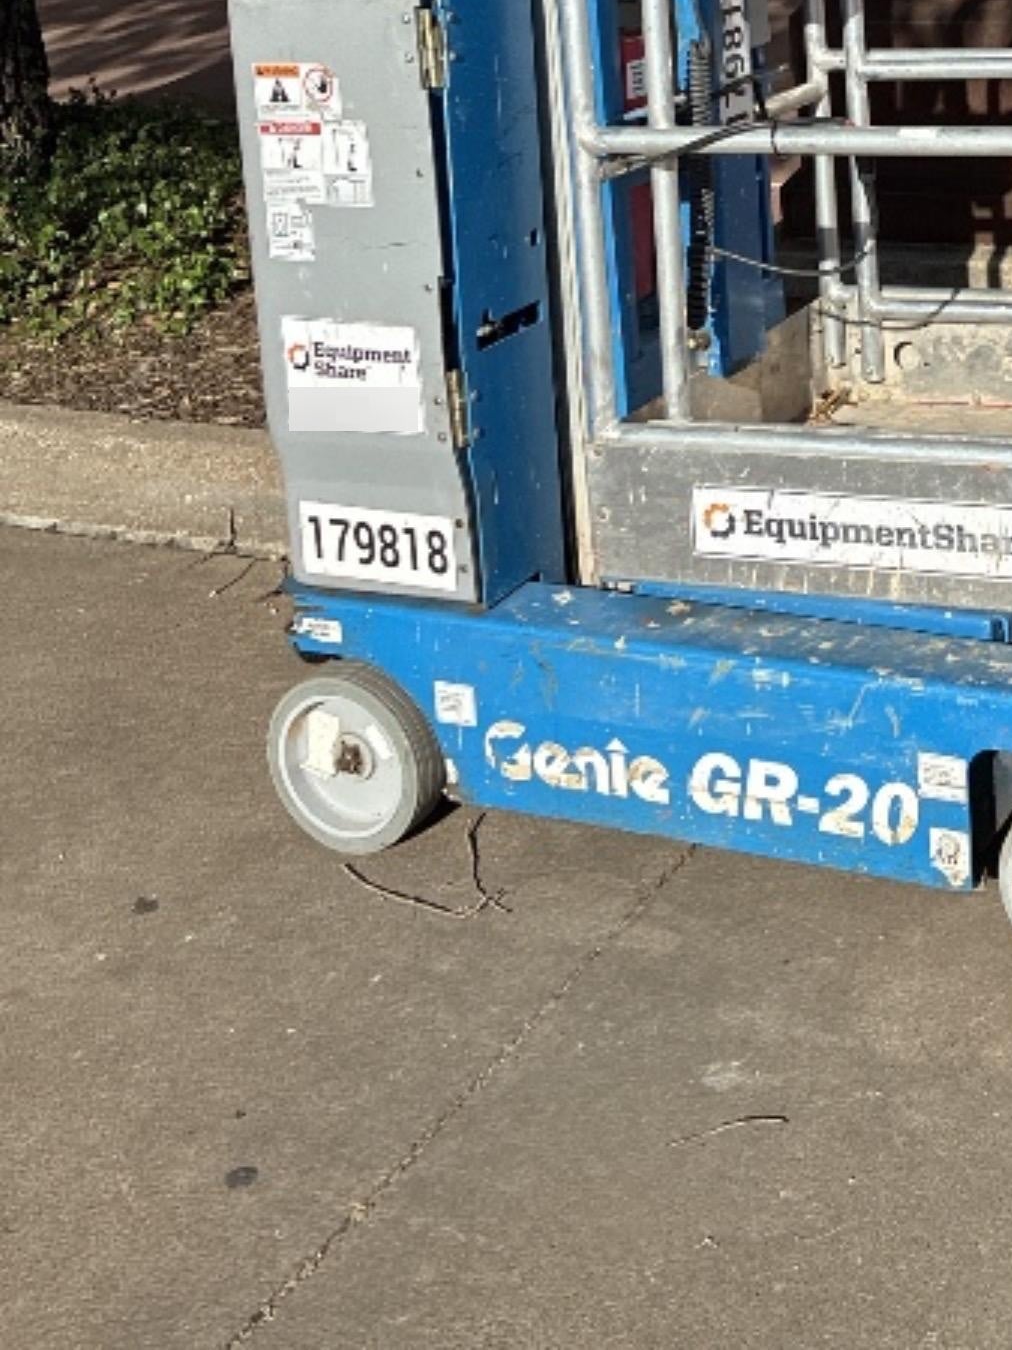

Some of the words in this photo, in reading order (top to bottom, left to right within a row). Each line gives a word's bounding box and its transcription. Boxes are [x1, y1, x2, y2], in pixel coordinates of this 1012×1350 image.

[312, 341, 412, 364] Equipment
[313, 361, 367, 381] Share
[308, 516, 448, 574] 179818
[484, 720, 671, 805] Genie
[689, 752, 920, 845] GR-20
